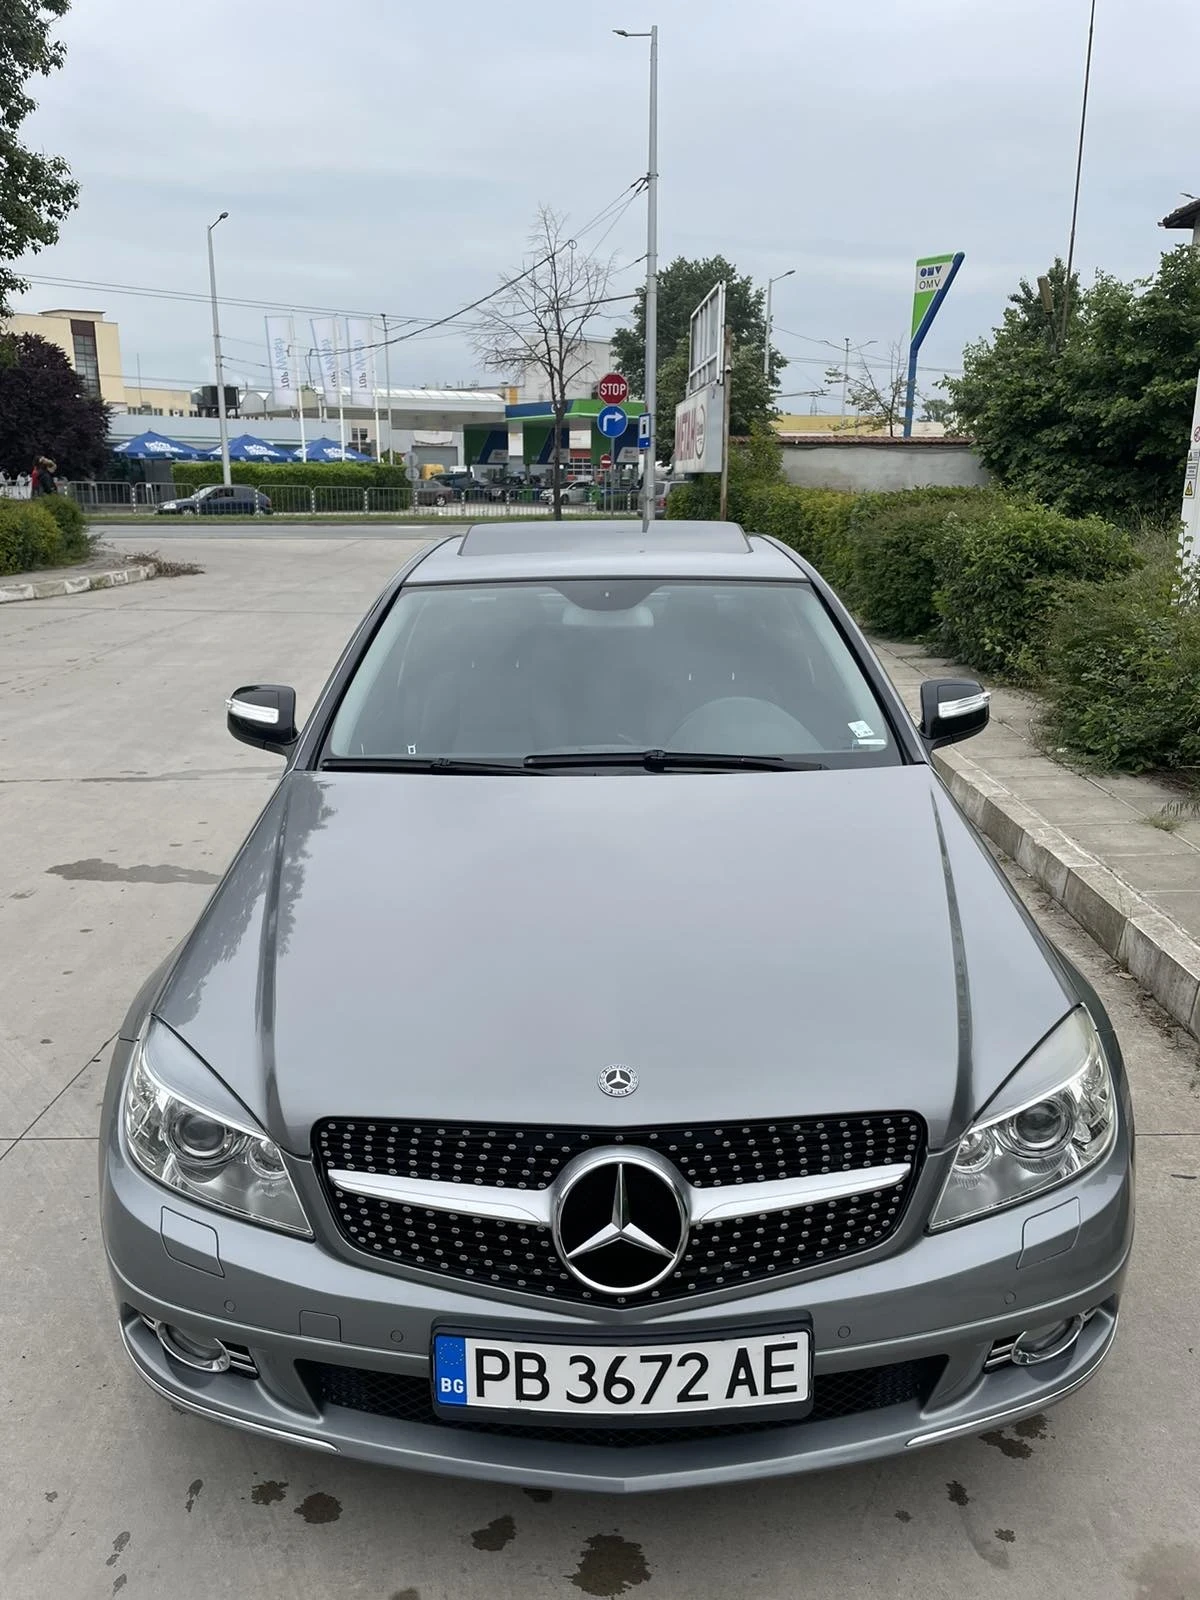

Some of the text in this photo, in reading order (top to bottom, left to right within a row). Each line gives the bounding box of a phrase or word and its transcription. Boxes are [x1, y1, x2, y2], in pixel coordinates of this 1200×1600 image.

[920, 265, 942, 277] OMV
[919, 279, 941, 290] OMV
[600, 383, 627, 396] STOP
[475, 1341, 799, 1405] PB 3672 AE
[440, 1377, 464, 1394] BG
